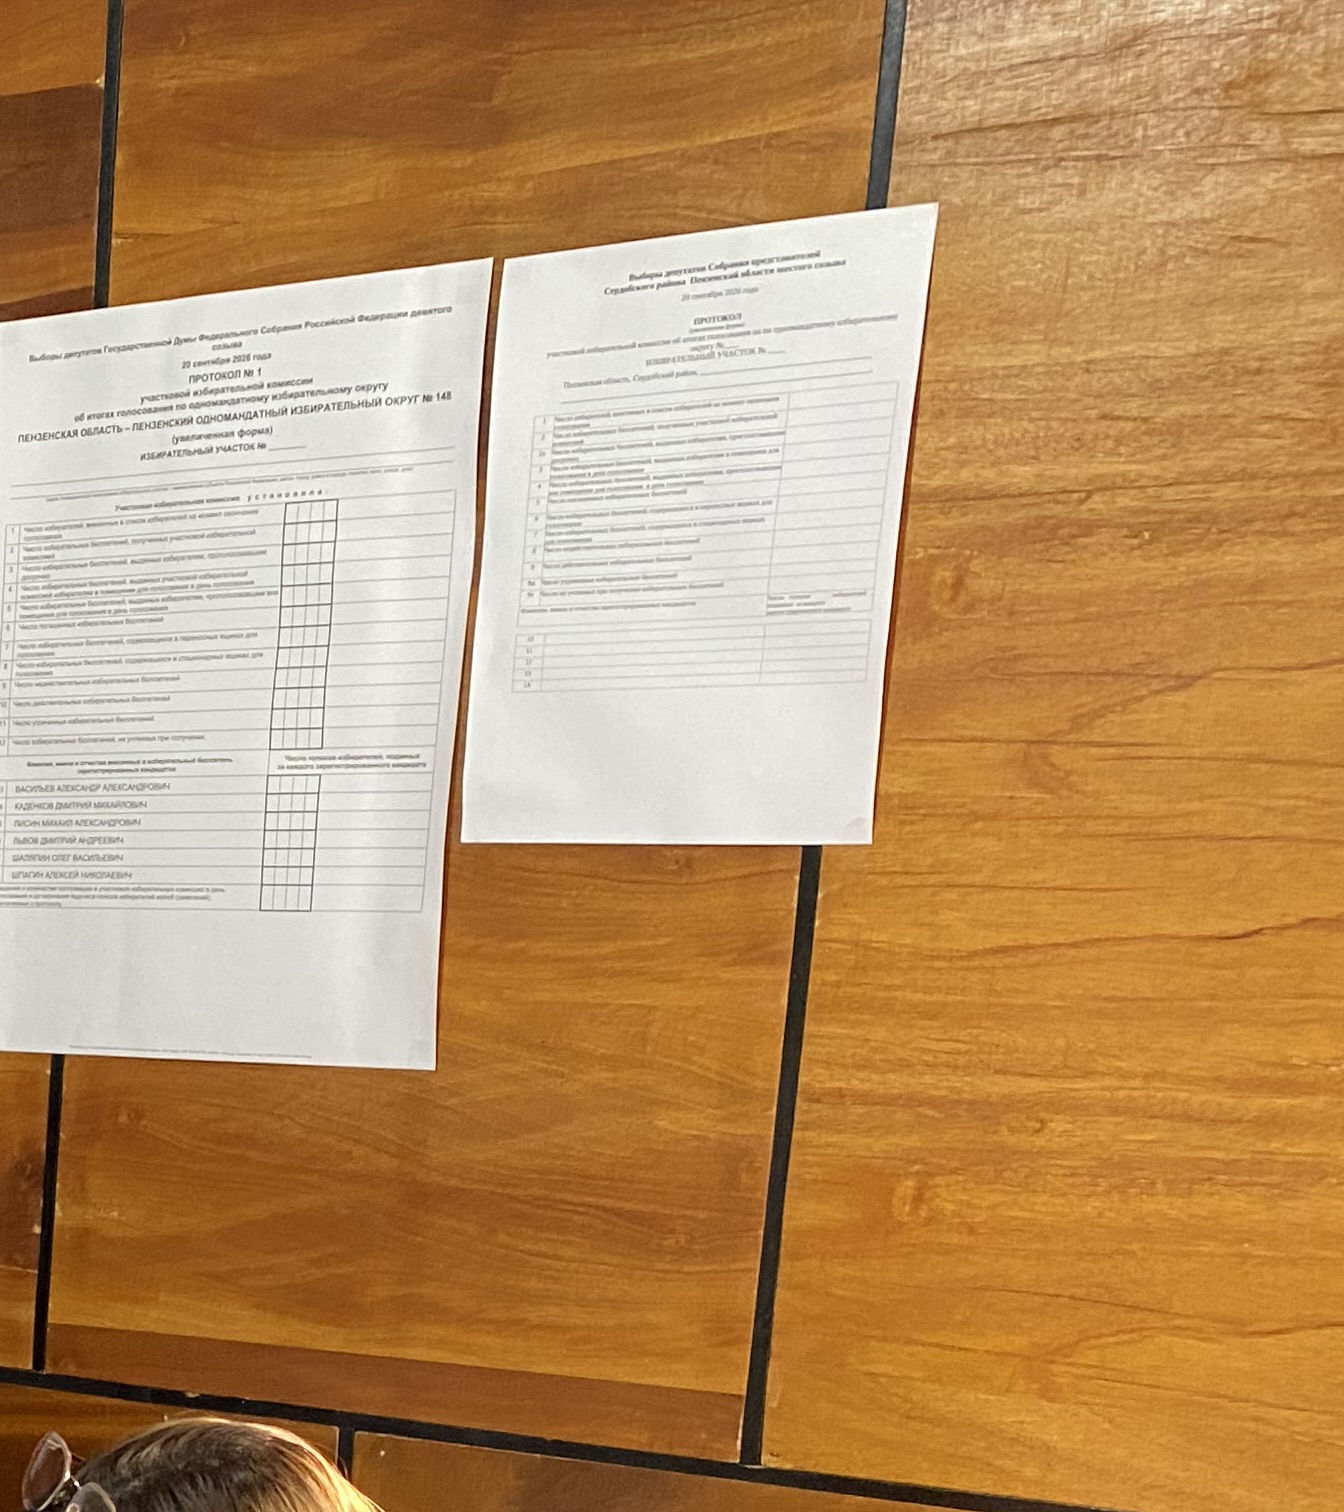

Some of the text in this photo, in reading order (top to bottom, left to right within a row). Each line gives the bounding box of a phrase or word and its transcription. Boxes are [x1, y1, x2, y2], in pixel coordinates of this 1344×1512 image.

[694, 313, 742, 325] ПРОТОКОЛ
[29, 353, 63, 363] Выборы
[104, 338, 172, 353] Государственной
[260, 324, 302, 334] Собрания
[304, 315, 355, 328] Российской
[357, 311, 408, 322] Федерации
[189, 369, 241, 384] ПРОТОКОЛ
[257, 367, 261, 376] 1
[74, 382, 389, 422] об итогах голосования по одномандатному избирательному округу
[140, 377, 313, 405] участковой избирательной комиссии
[18, 429, 78, 443] ПЕНЗЕНСКАЯ
[80, 425, 123, 437] ОБЛАСТЬ
[132, 416, 194, 431] ПЕНЗЕНСКИЙ
[196, 407, 288, 425] ОДНОМАНДАТНЫЙ
[290, 397, 382, 415] ИЗБИРАТЕЛЬНЫЙ
[385, 394, 420, 406] ОКРУГ
[172, 426, 273, 445] (увеличенная форма)
[140, 446, 214, 461] ИЗБИРАТЕЛЬНЫЙ
[215, 443, 255, 454] УЧАСТОК
